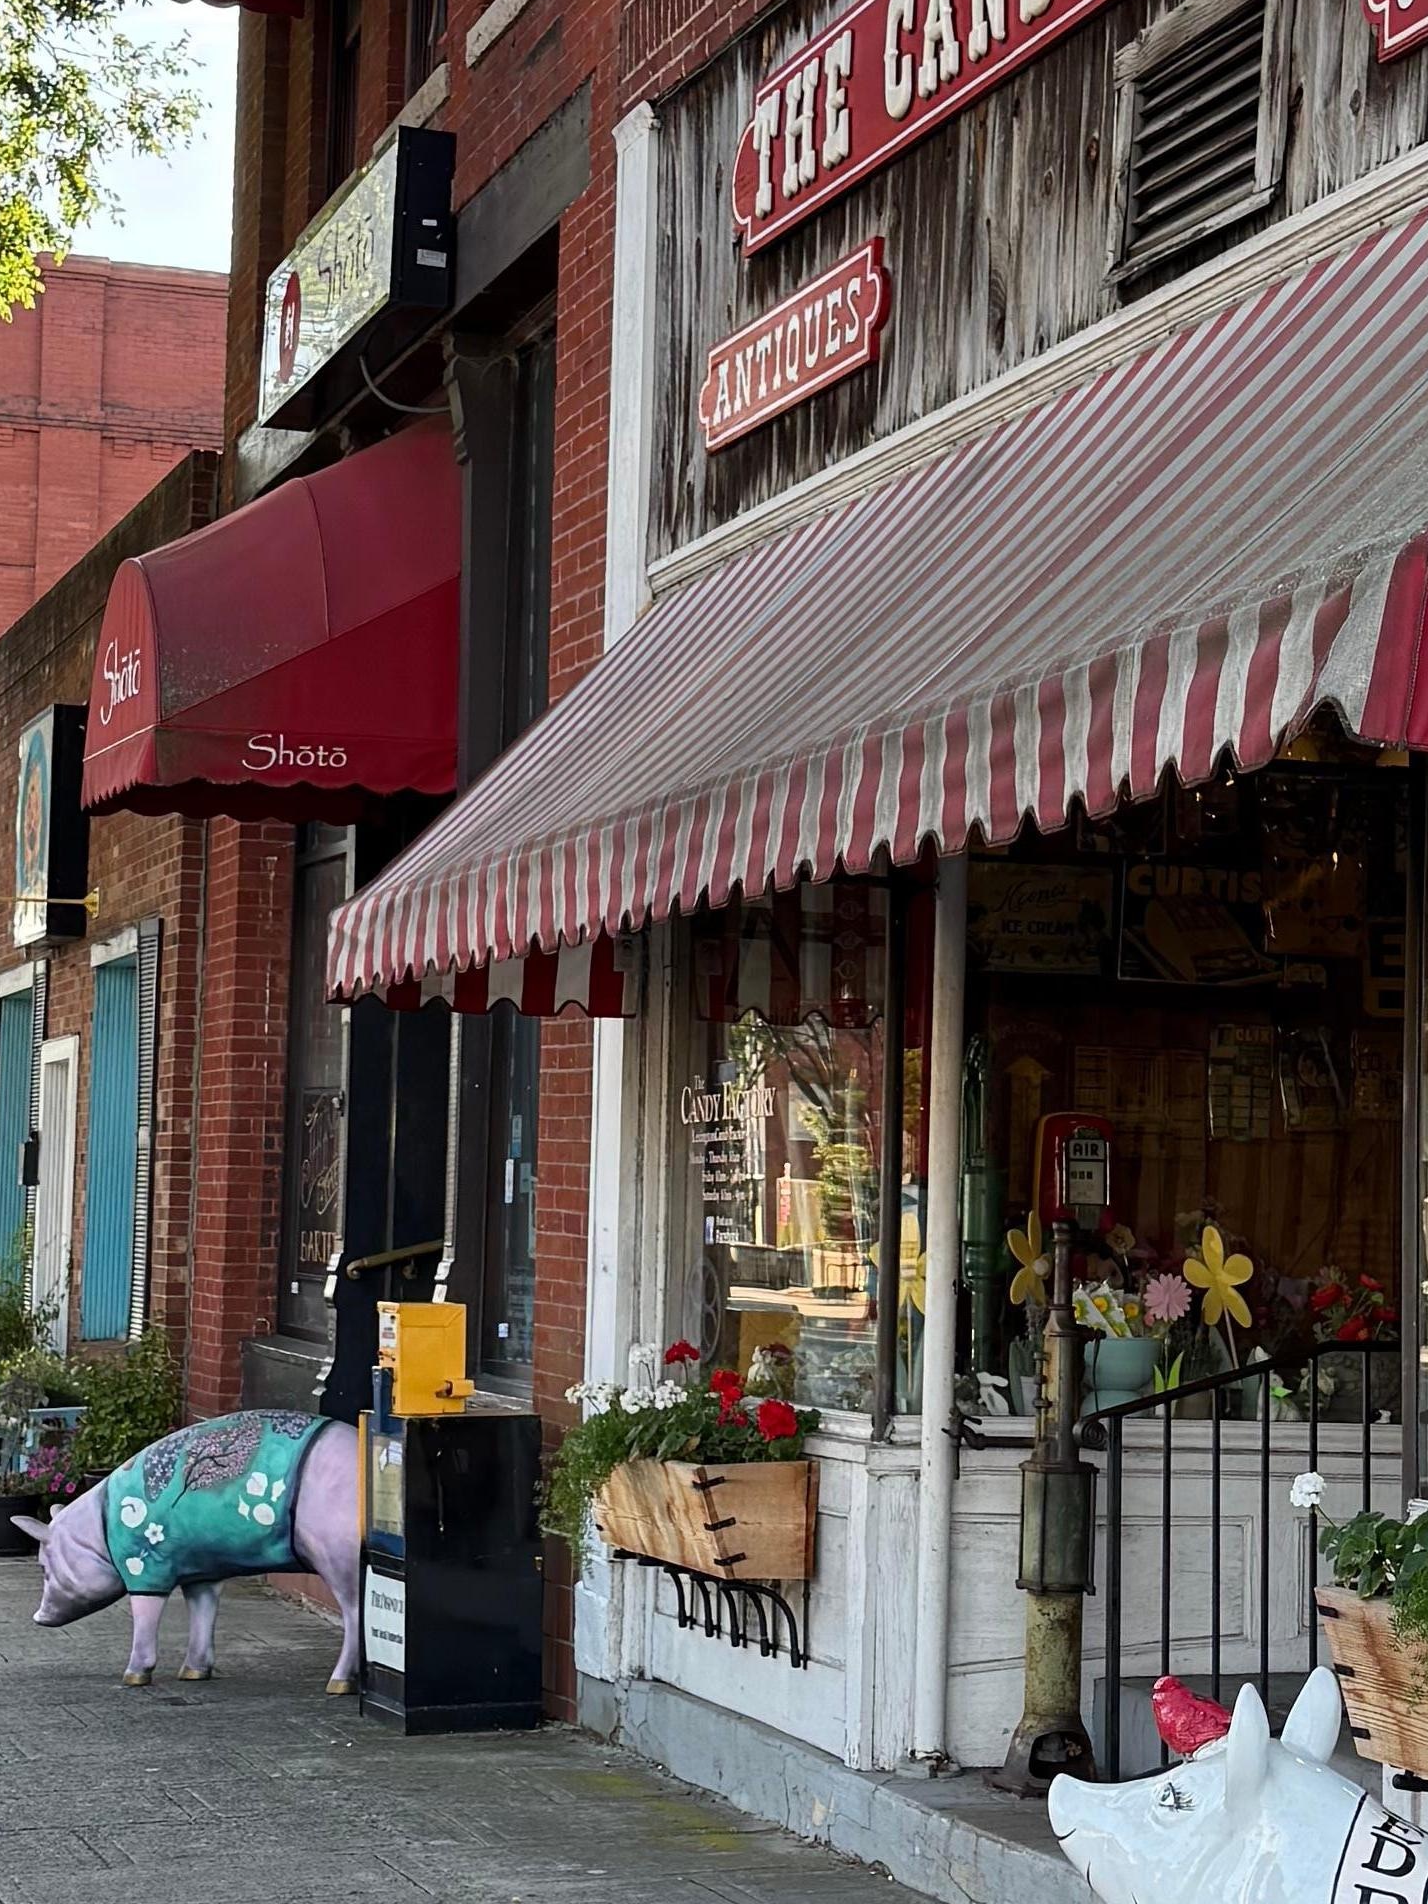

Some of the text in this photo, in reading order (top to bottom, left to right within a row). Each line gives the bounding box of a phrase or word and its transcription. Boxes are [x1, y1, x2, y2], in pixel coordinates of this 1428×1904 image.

[748, 42, 858, 220] THE
[709, 274, 866, 427] ANTIQUES
[681, 1081, 777, 1125] CANDY FACTORY
[694, 1075, 705, 1090] The
[1073, 1142, 1100, 1157] AIR
